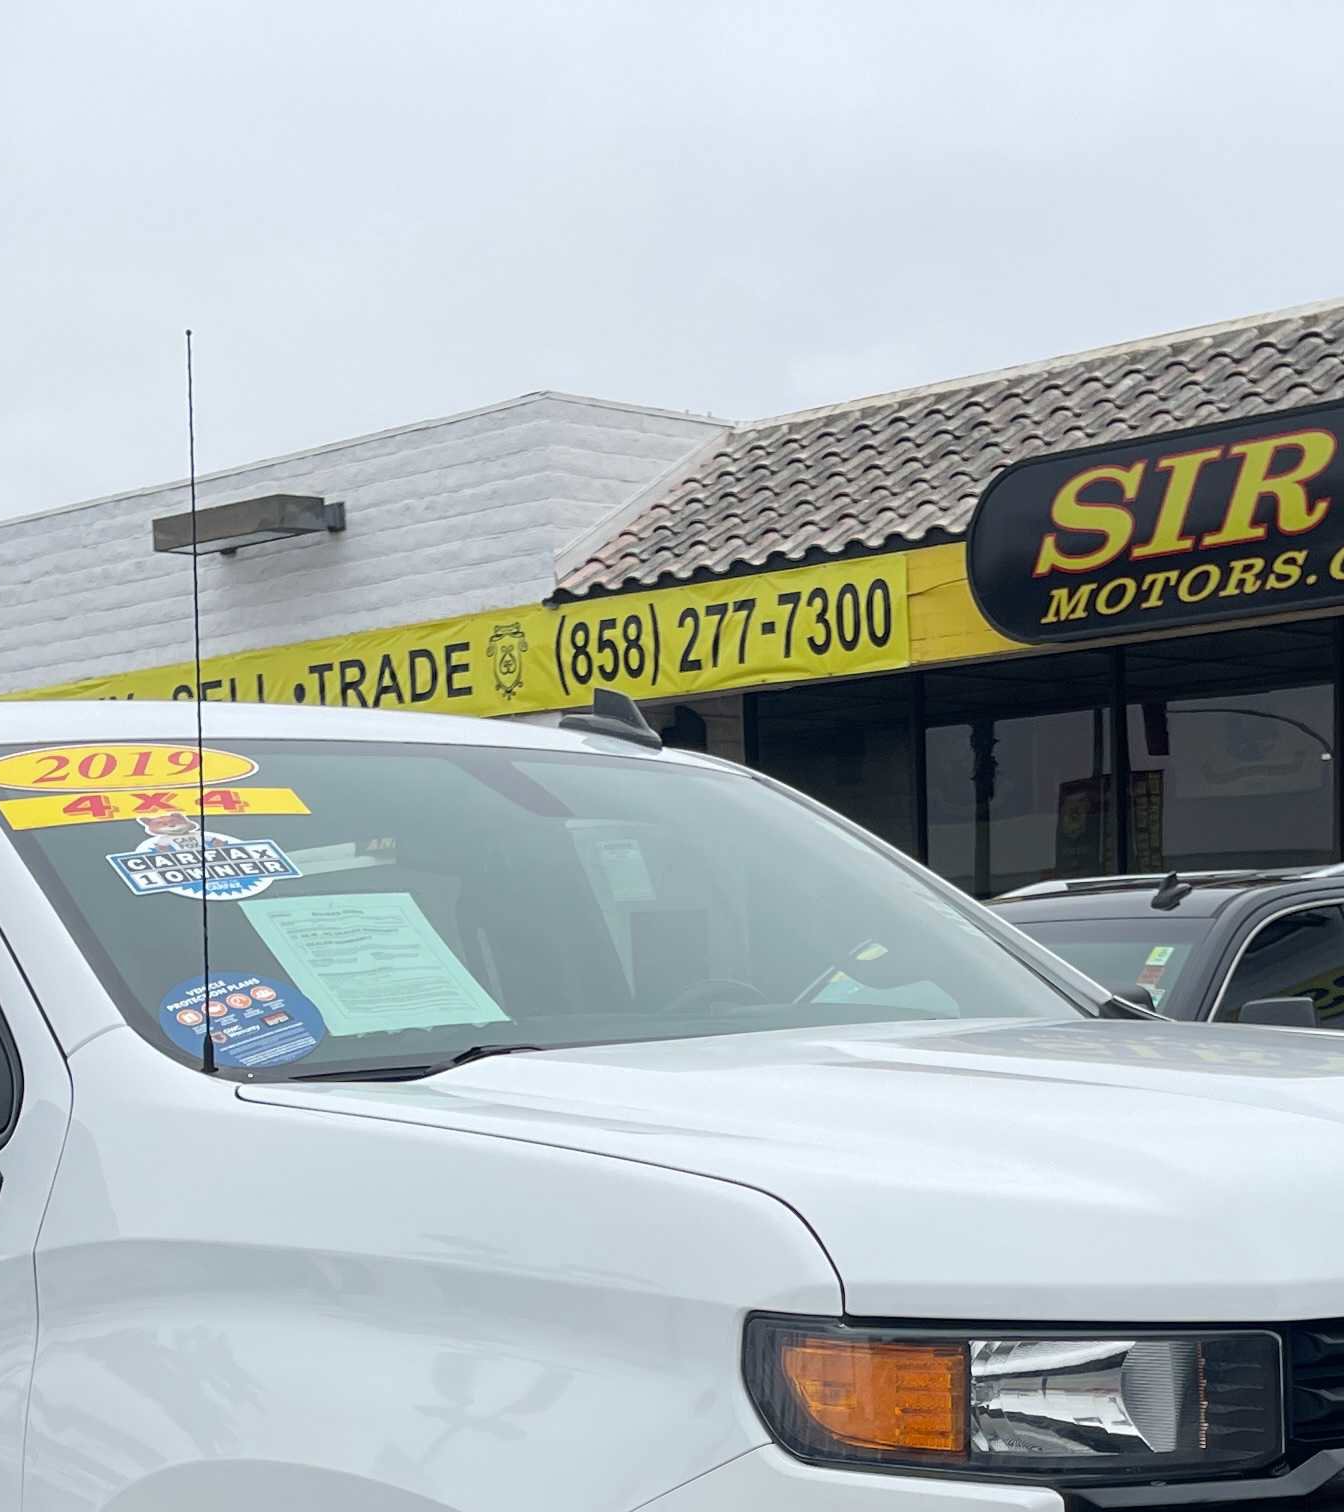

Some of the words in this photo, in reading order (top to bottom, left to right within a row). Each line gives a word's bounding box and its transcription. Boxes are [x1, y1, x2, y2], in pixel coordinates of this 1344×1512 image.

[555, 603, 660, 695] (858)
[677, 578, 893, 673] 277-7300
[32, 750, 202, 785] 2019
[127, 848, 274, 871] CARFAX
